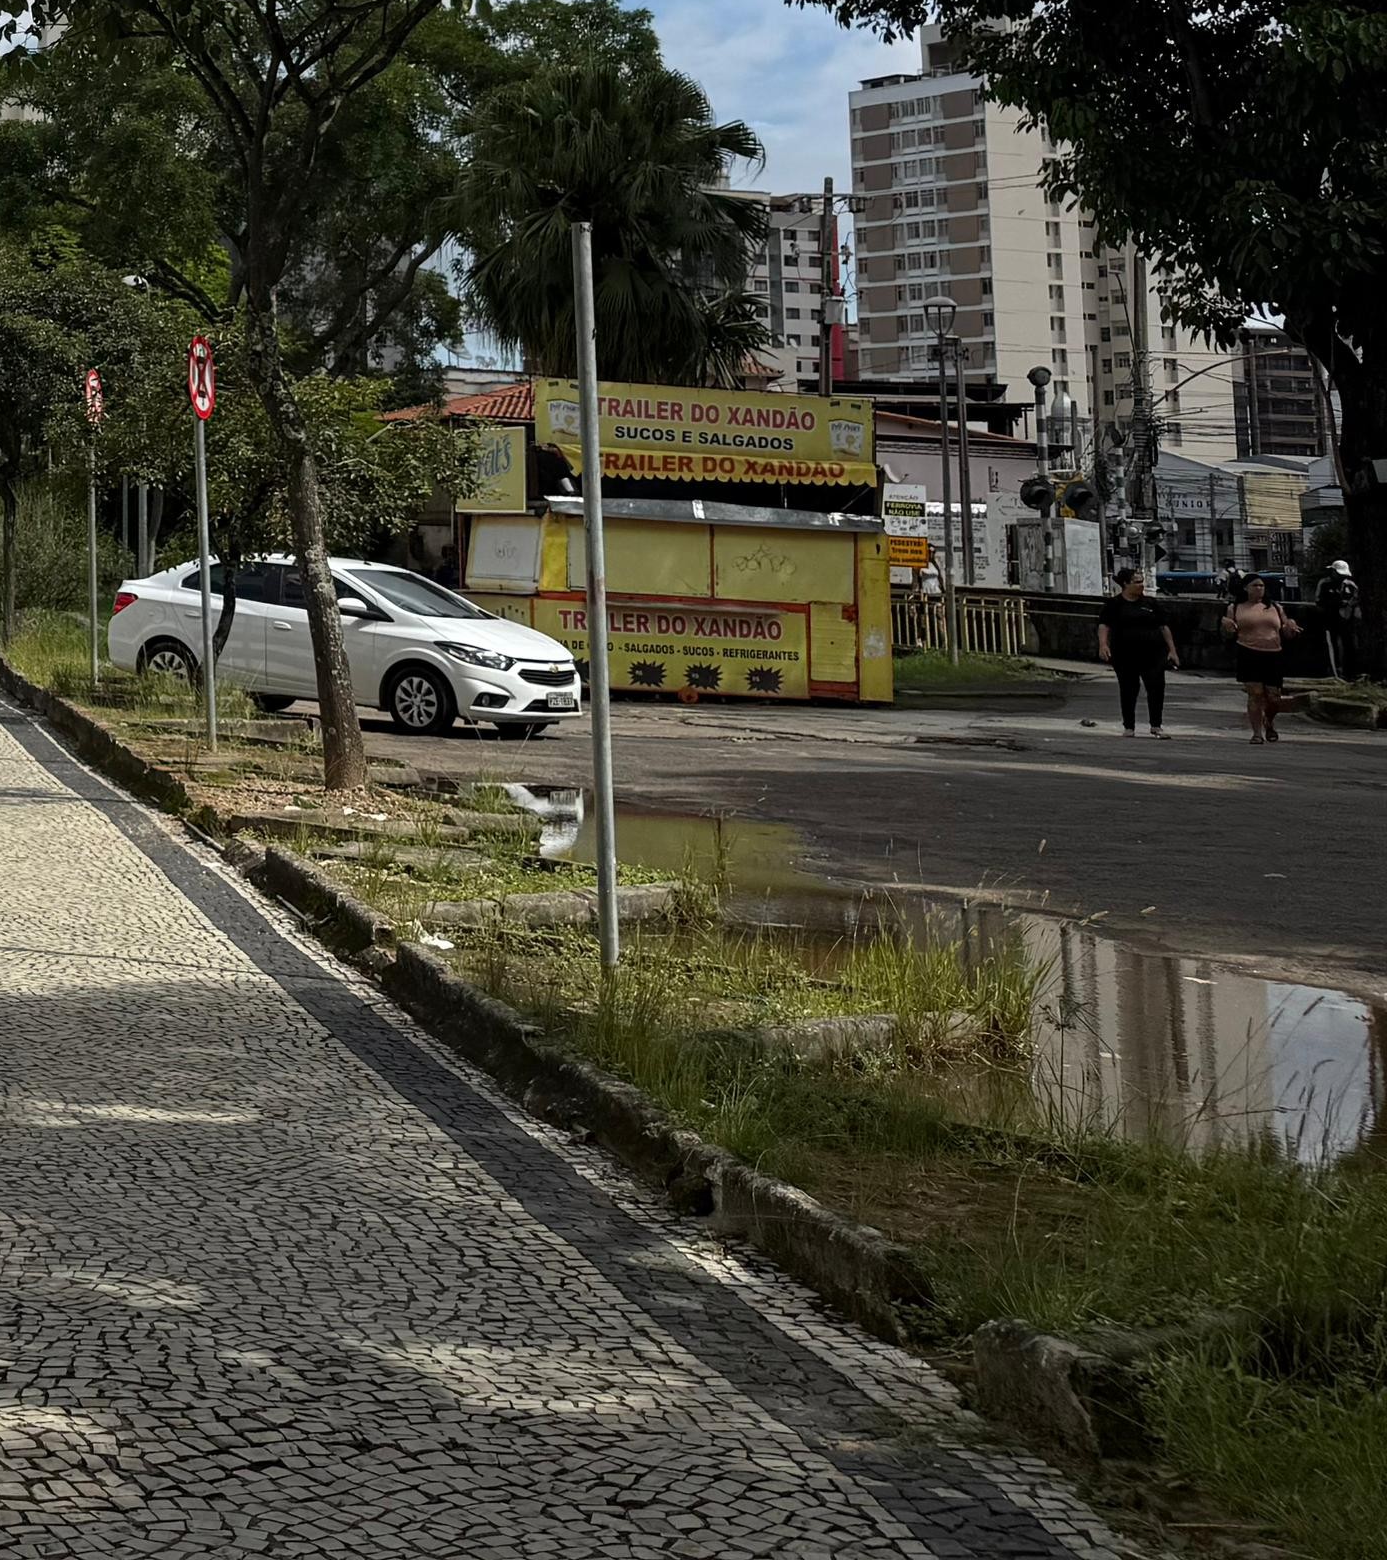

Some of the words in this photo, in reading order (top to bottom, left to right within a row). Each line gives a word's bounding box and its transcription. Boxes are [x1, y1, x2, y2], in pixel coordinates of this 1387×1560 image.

[597, 396, 684, 422] TRAILER
[691, 403, 720, 425] DO
[726, 406, 816, 432] XANDÃO
[614, 426, 676, 442] SUCOS
[682, 430, 692, 443] E
[698, 431, 794, 451] SALGADOS
[599, 452, 695, 473] RAILER
[702, 456, 736, 475] DO
[558, 609, 651, 633] TRLER
[657, 614, 687, 635] DO
[693, 615, 782, 641] XANDÃO
[571, 640, 584, 650] DE
[624, 642, 675, 654] SALGADOS
[682, 645, 715, 656] SUCOS
[722, 647, 800, 661] REFRIGERANTES
